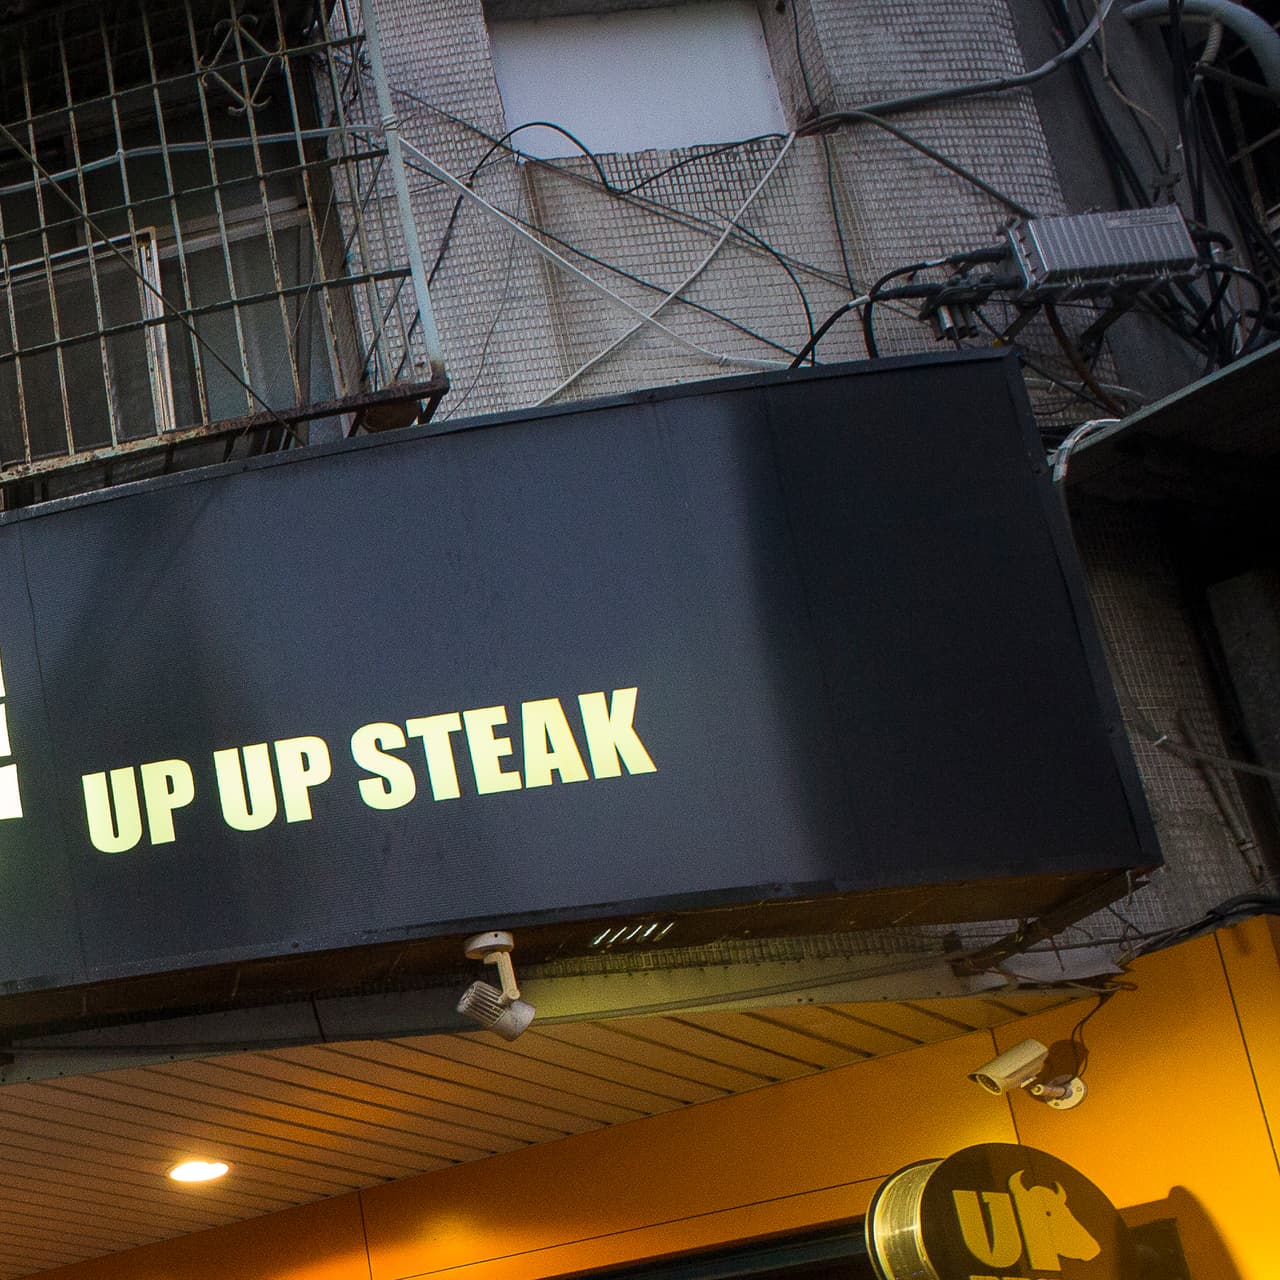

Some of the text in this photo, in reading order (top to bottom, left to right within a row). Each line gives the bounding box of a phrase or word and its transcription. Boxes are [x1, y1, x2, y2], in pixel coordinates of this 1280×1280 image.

[81, 686, 658, 854] UP UP STEAK
